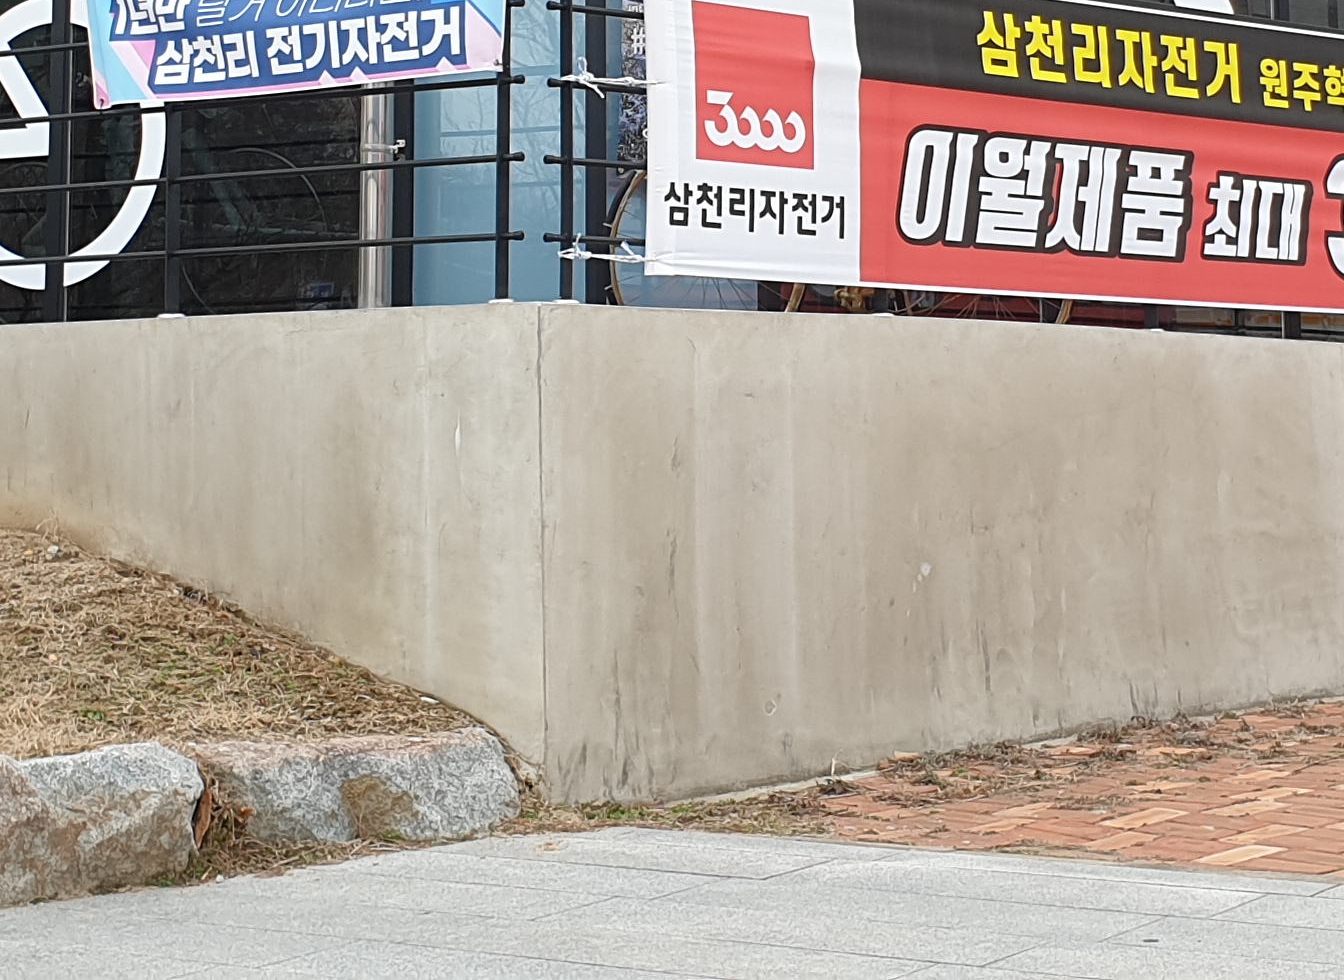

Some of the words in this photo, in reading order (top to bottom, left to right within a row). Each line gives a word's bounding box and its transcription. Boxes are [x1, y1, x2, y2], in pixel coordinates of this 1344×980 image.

[154, 30, 258, 86] 삼천리
[266, 4, 462, 77] 전기자전거
[976, 9, 1243, 106] 삼천리자전거
[663, 181, 846, 240] 삼천리자전거
[898, 127, 1186, 258] 이월제품
[1202, 174, 1309, 263] 최대
